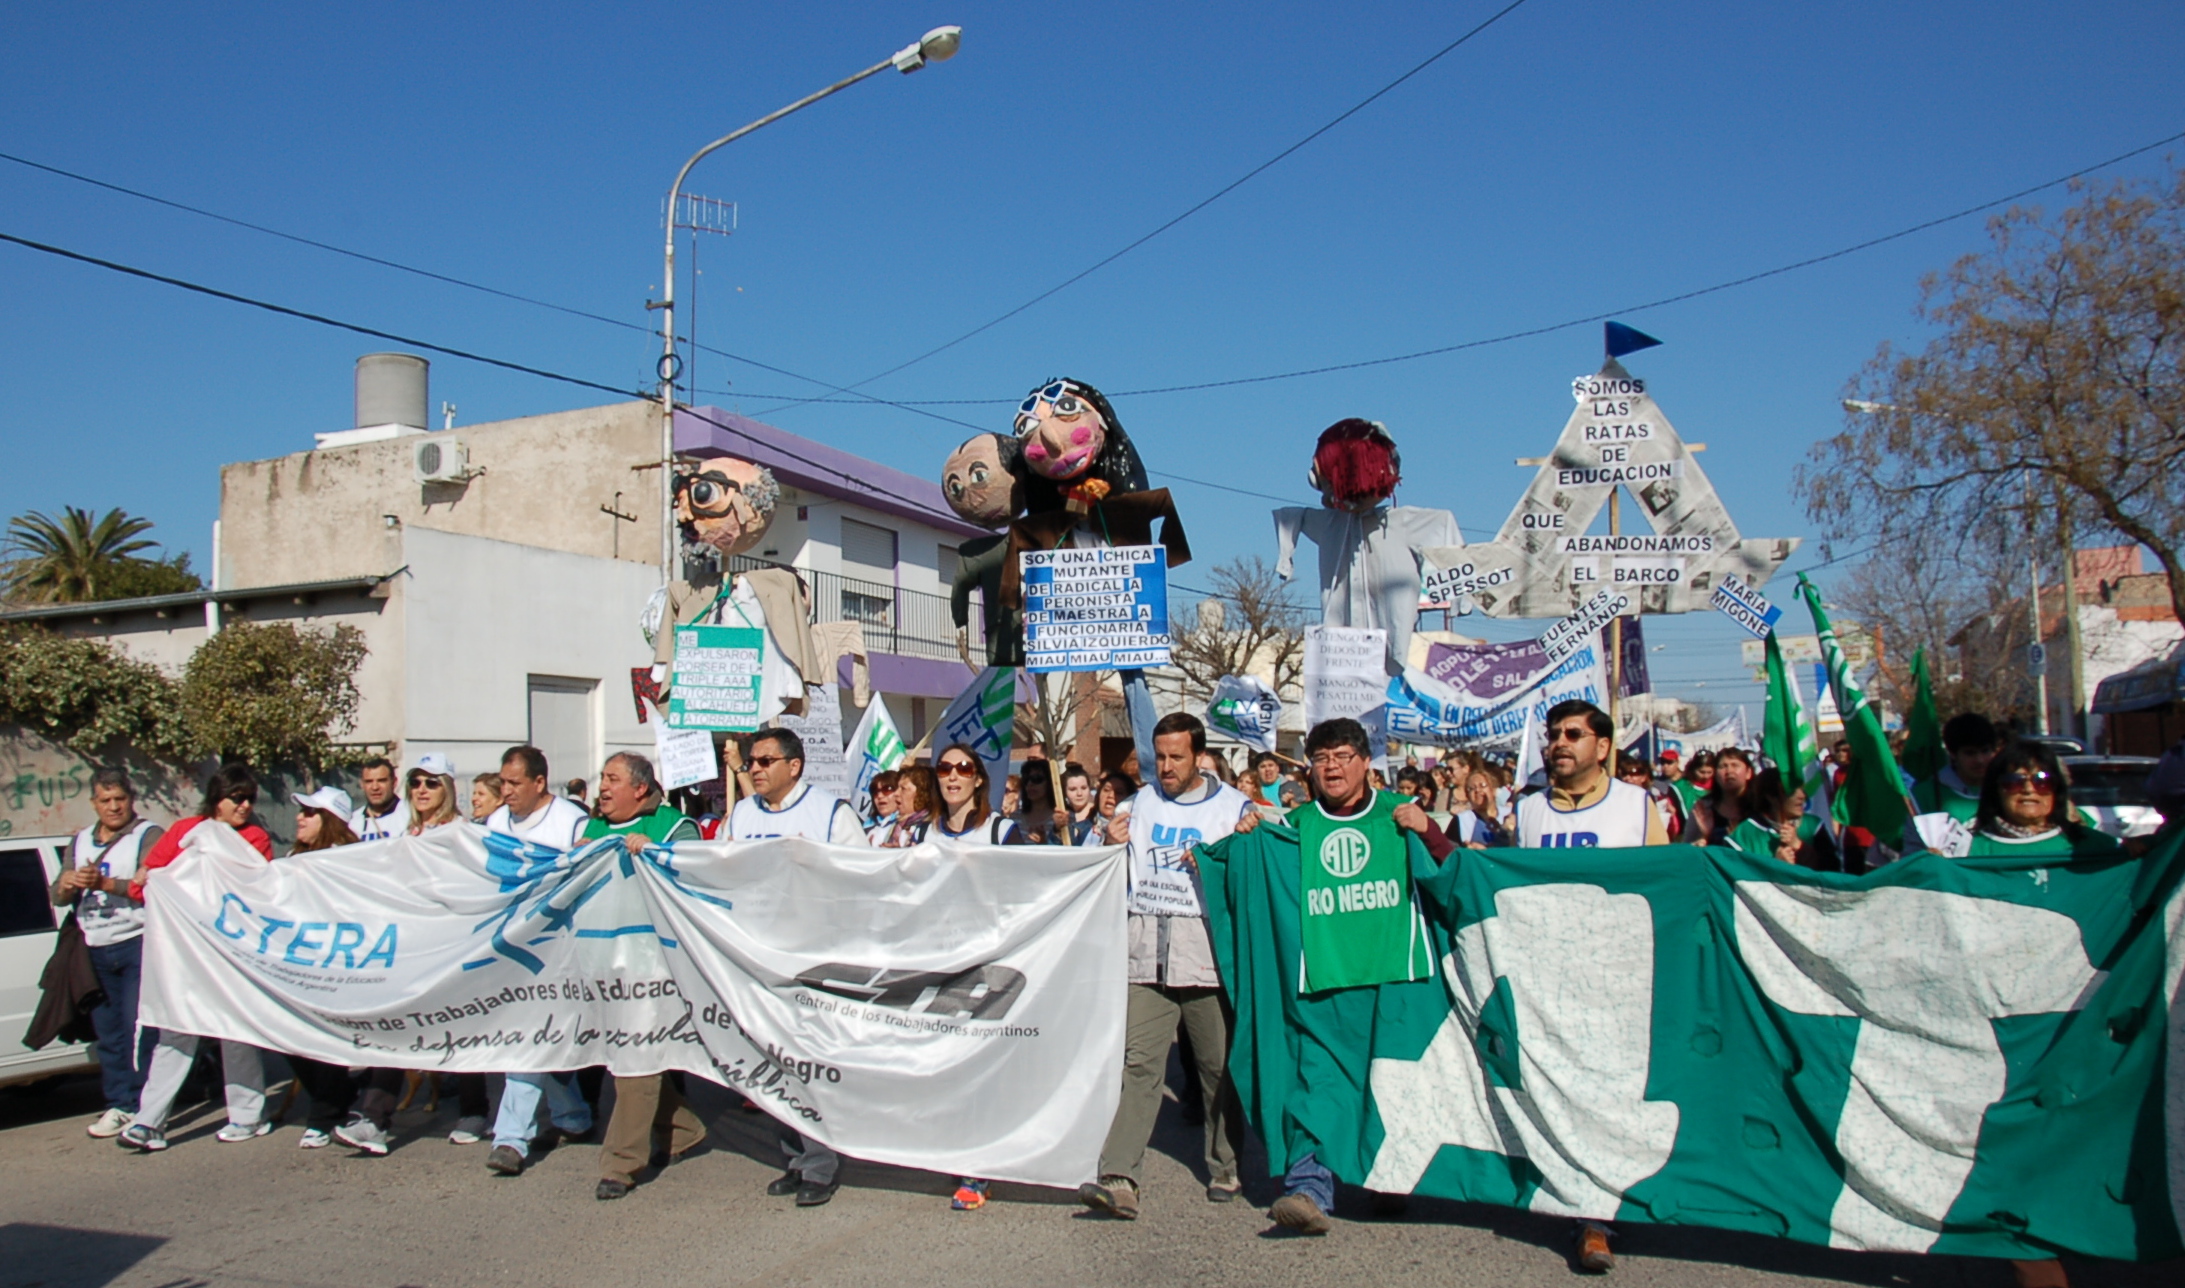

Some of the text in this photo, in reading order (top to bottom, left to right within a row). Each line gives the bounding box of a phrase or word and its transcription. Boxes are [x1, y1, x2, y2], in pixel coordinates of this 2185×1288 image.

[1574, 378, 1645, 396] SOMOS
[1593, 402, 1630, 417] LAS
[1585, 423, 1650, 441] RATAS
[1601, 447, 1626, 463] DE
[1558, 463, 1673, 486] EDUCACION
[1521, 513, 1565, 530] QUE
[1564, 536, 1713, 552] ABANDONAMOS
[1025, 549, 1152, 566] SOY UNA CHICA
[1054, 564, 1131, 579] MUTANTE
[1426, 562, 1475, 589] ALDO
[1573, 565, 1681, 583] EL BARCO
[1028, 579, 1141, 596] DE RADICAL A
[1428, 567, 1512, 605] SPESSOT
[1044, 593, 1133, 610] PERONISTA
[1722, 575, 1766, 615] MARIA
[1028, 607, 1150, 624] DE MAESTRA A
[1538, 591, 1610, 649] FUENTES
[1710, 590, 1769, 637] MIGONE
[1036, 621, 1146, 638] FUNCIONARIA
[1306, 631, 1384, 643] NO TENGO DOS
[1547, 595, 1629, 663] FERNANDO
[679, 635, 697, 647] ME
[1027, 634, 1171, 652] SILVIA IZQUIERDO
[1320, 644, 1371, 655] DEDOS DE
[678, 648, 757, 660] EXPULSARON
[1025, 653, 1067, 667] MIAU
[1070, 650, 1111, 665] MIAU
[676, 662, 763, 674] POR SER DE LA
[1325, 659, 1363, 668] FRENTE
[680, 674, 747, 687] TRIPLE AAA
[1318, 679, 1368, 688] MANGO Y
[671, 687, 753, 701] AUTORITARIO
[1361, 692, 1375, 701] ME
[686, 699, 756, 712] ALCAHUETE
[1330, 704, 1362, 713] AMAN
[671, 713, 757, 726] Y ATORRANTE
[1323, 833, 1364, 873] ATE
[1160, 882, 1188, 894] ESCUELA
[1163, 895, 1194, 907] POPULAR
[1308, 878, 1400, 916] RIO NEGRO
[213, 892, 398, 970] CTERA
[378, 1017, 406, 1031] de
[406, 982, 557, 1027] Trabajadores
[562, 977, 580, 1000] de
[702, 1002, 732, 1030] de
[794, 992, 1040, 1039] central de los trabajadores argentinos
[409, 1030, 525, 1066] defensa
[533, 1013, 564, 1046] de
[573, 1013, 600, 1046] la
